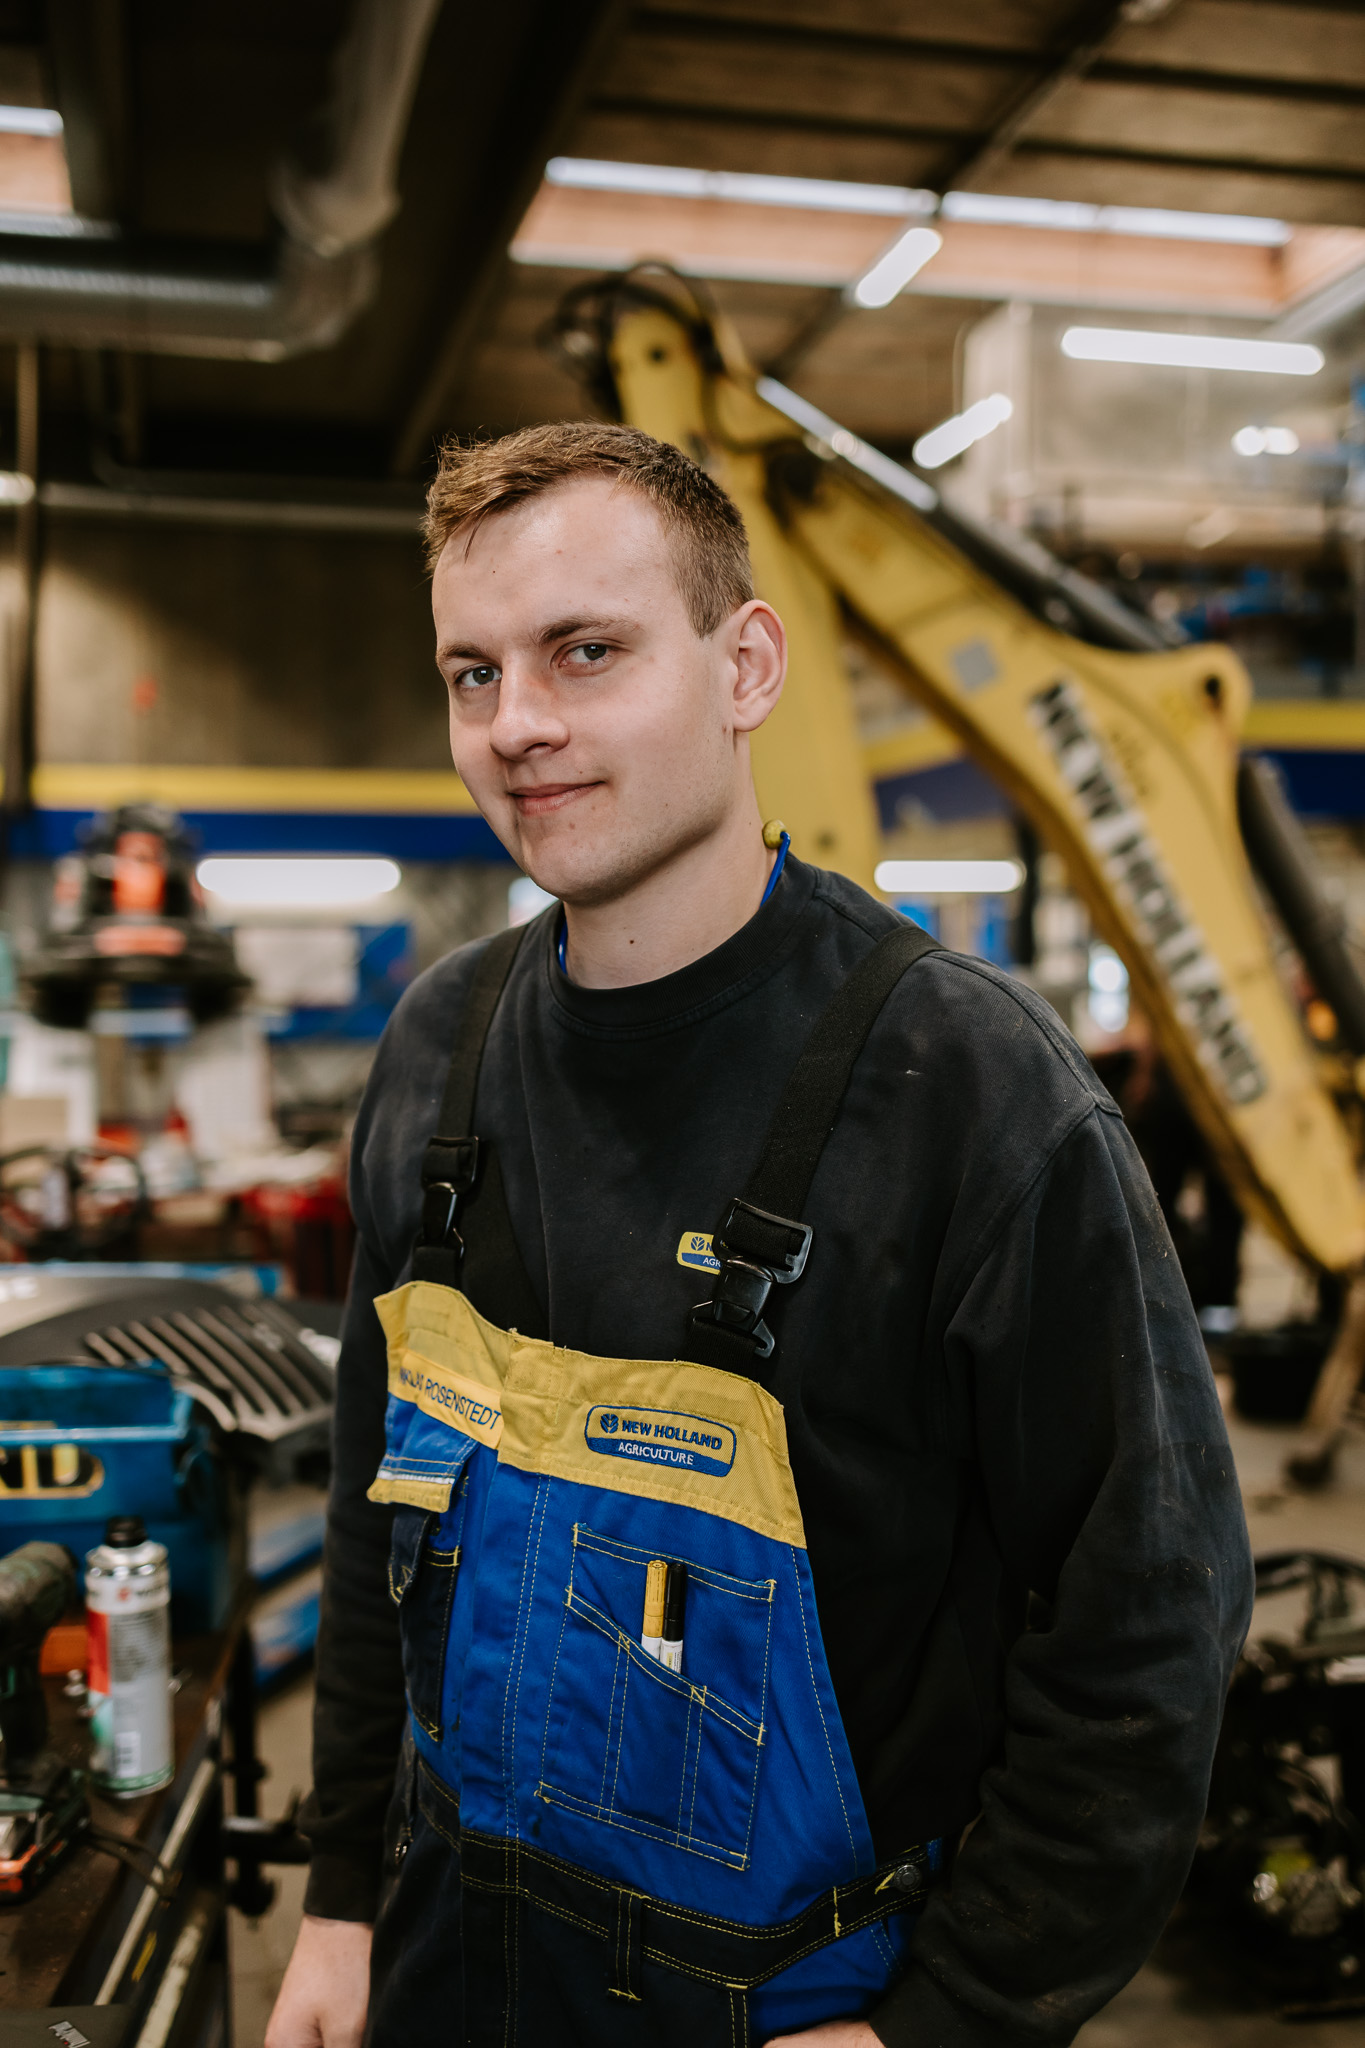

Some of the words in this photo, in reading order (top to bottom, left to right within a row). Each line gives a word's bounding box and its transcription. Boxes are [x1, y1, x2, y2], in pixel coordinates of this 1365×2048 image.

[424, 1378, 502, 1430] ROSENSTEDT
[622, 1419, 652, 1436] NEW
[654, 1424, 722, 1450] HOLLAND
[618, 1442, 694, 1466] AGRICULTURE
